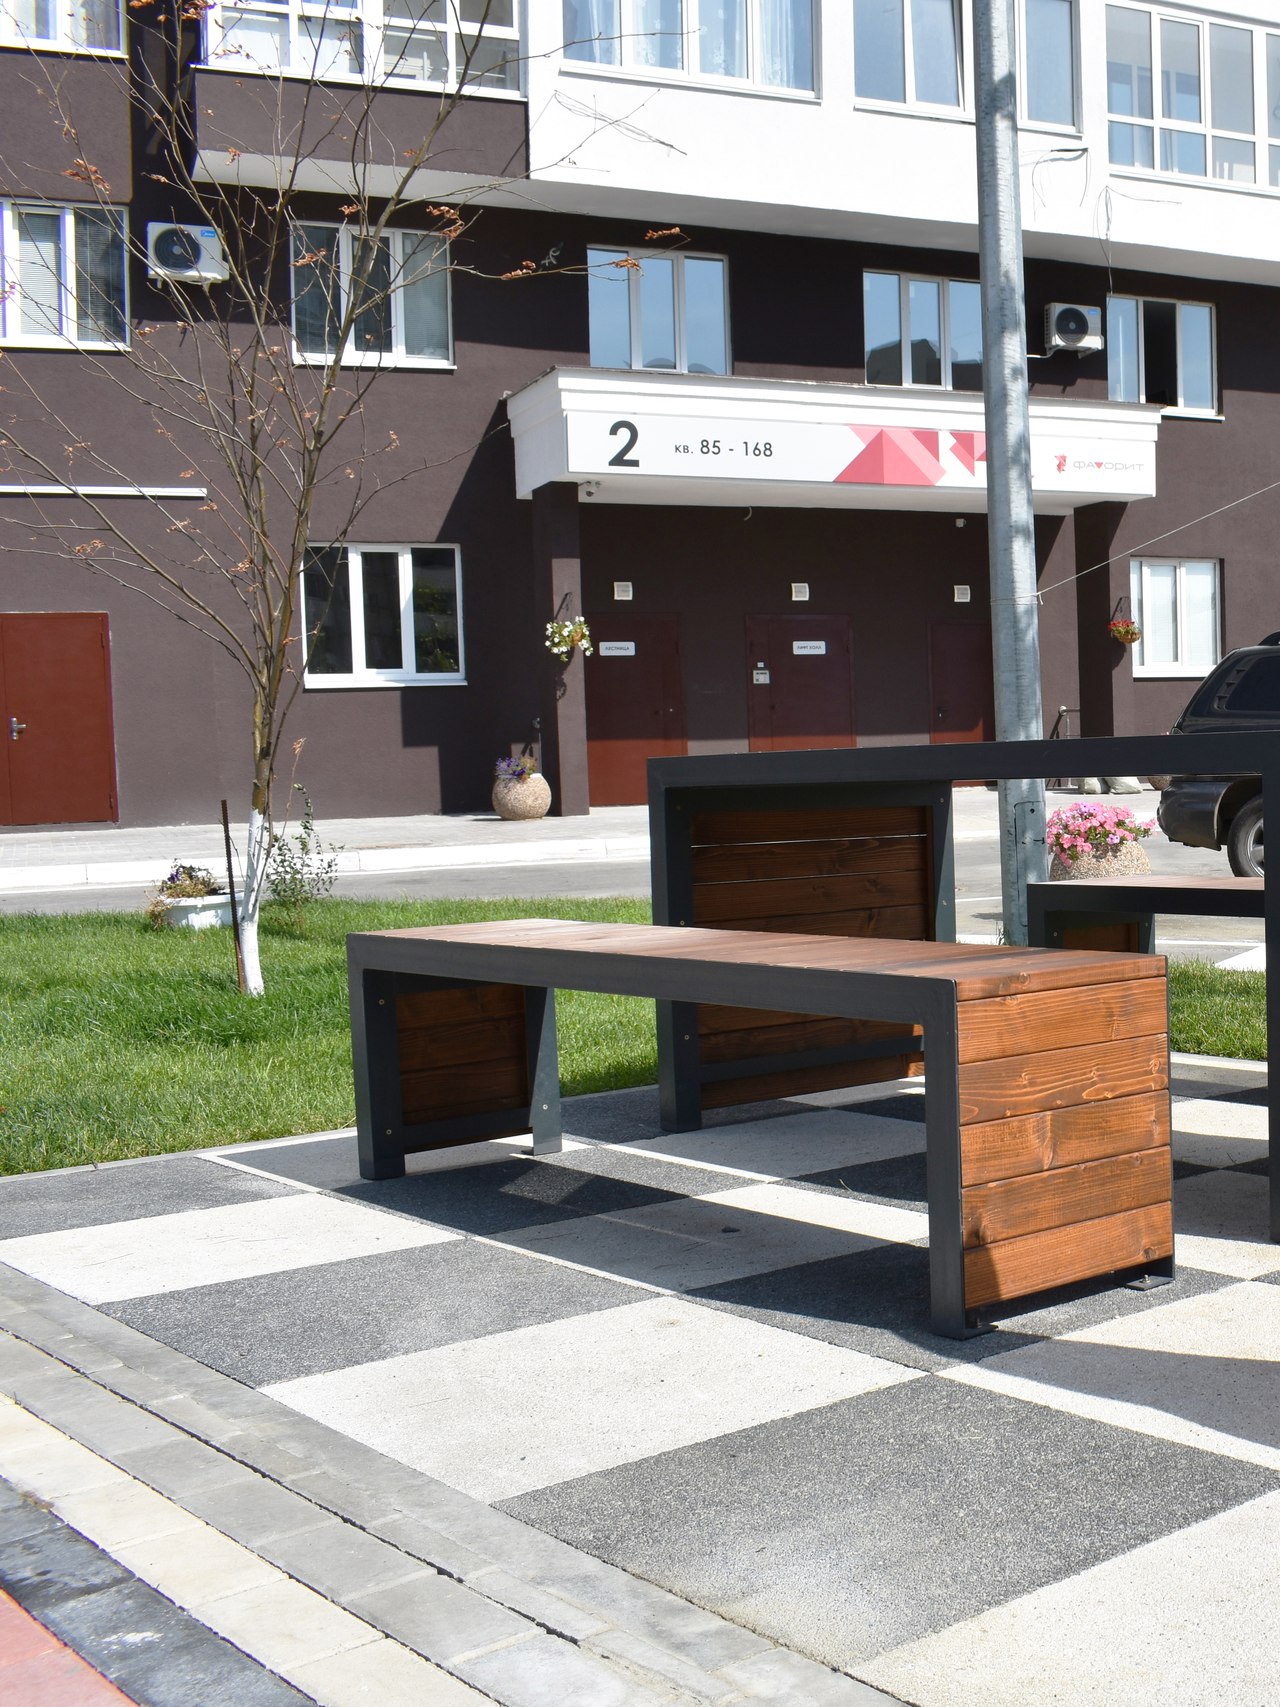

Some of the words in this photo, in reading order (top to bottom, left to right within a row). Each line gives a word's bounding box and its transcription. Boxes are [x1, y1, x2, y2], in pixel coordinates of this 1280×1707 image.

[608, 420, 640, 467] 2
[700, 439, 721, 455] 85
[743, 441, 773, 457] 168
